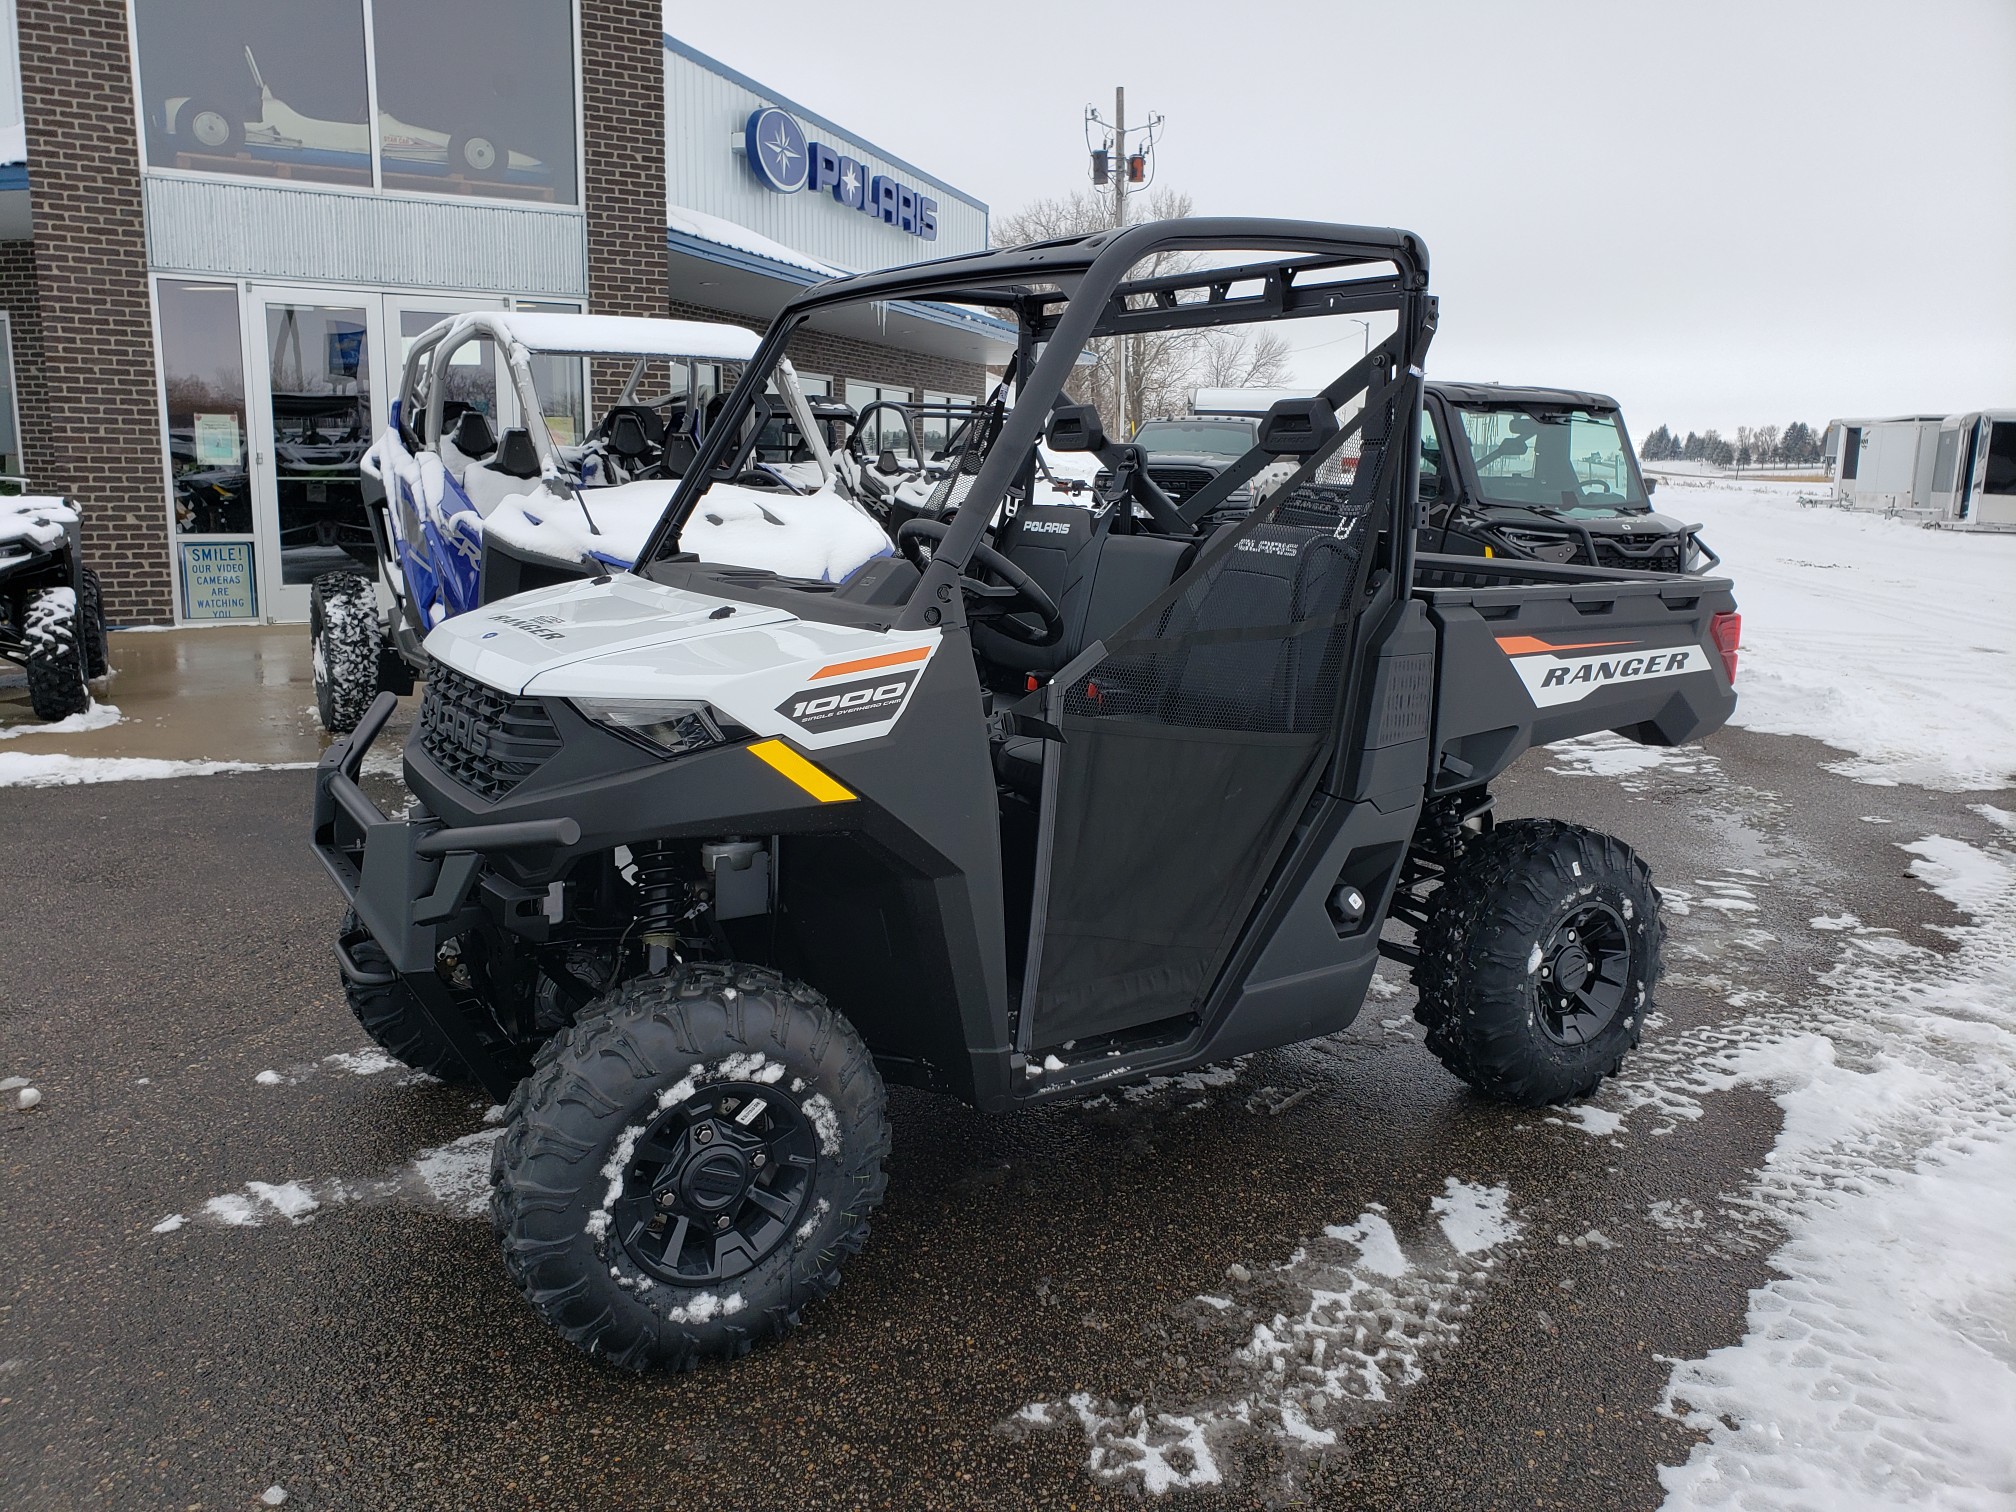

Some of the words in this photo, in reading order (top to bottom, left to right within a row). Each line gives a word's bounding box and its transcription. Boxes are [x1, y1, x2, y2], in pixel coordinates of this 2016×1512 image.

[808, 141, 938, 242] POLARIS
[857, 490, 890, 518] ZR
[1022, 520, 1071, 535] POLARIS
[191, 547, 243, 562] SMILE!
[1233, 538, 1299, 557] OLARIS
[191, 564, 212, 574] OUR
[216, 563, 244, 573] VIDEO
[196, 575, 241, 586] CAMERAS
[211, 587, 229, 597] ARE
[197, 598, 245, 609] WATCHING
[212, 610, 231, 618] YOU
[488, 615, 566, 640] RANGER
[1540, 651, 1690, 689] RANGER
[792, 681, 907, 718] 1000
[801, 712, 834, 723] SINGLE
[836, 702, 882, 716] OVERHEAD
[882, 698, 902, 706] CAM
[421, 685, 487, 758] POLARIS
